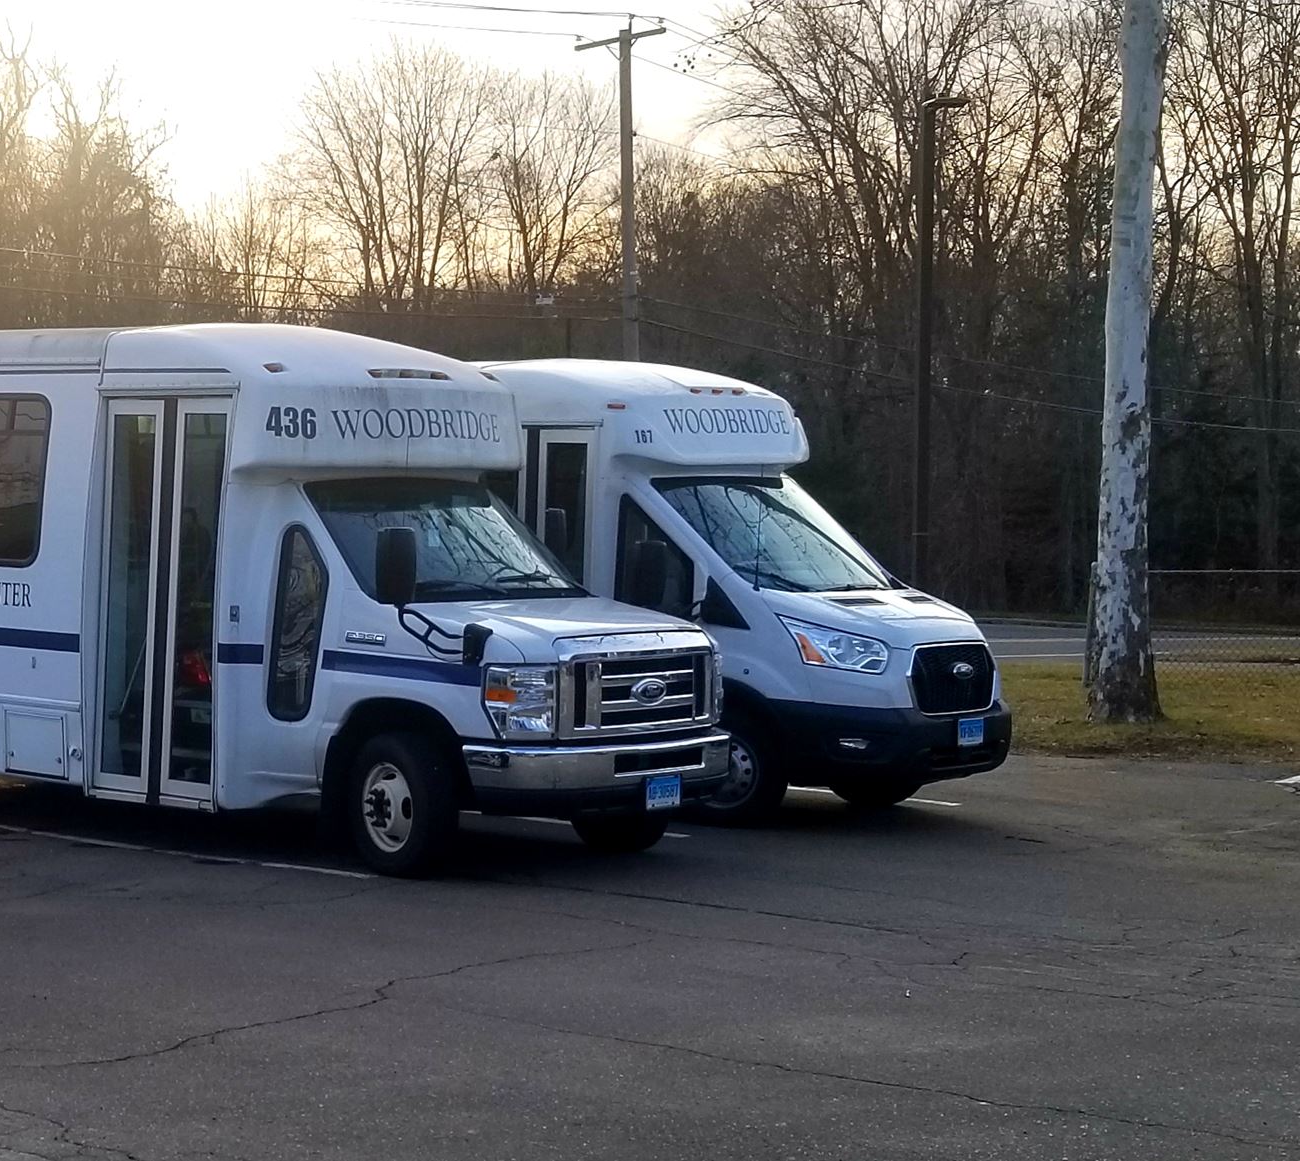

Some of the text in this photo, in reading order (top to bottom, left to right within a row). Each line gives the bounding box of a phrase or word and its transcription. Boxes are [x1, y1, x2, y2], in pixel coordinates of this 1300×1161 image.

[266, 406, 501, 443] 436 WOODBRIDGE
[663, 408, 790, 435] WOODBRIDGE
[634, 430, 653, 443] 167
